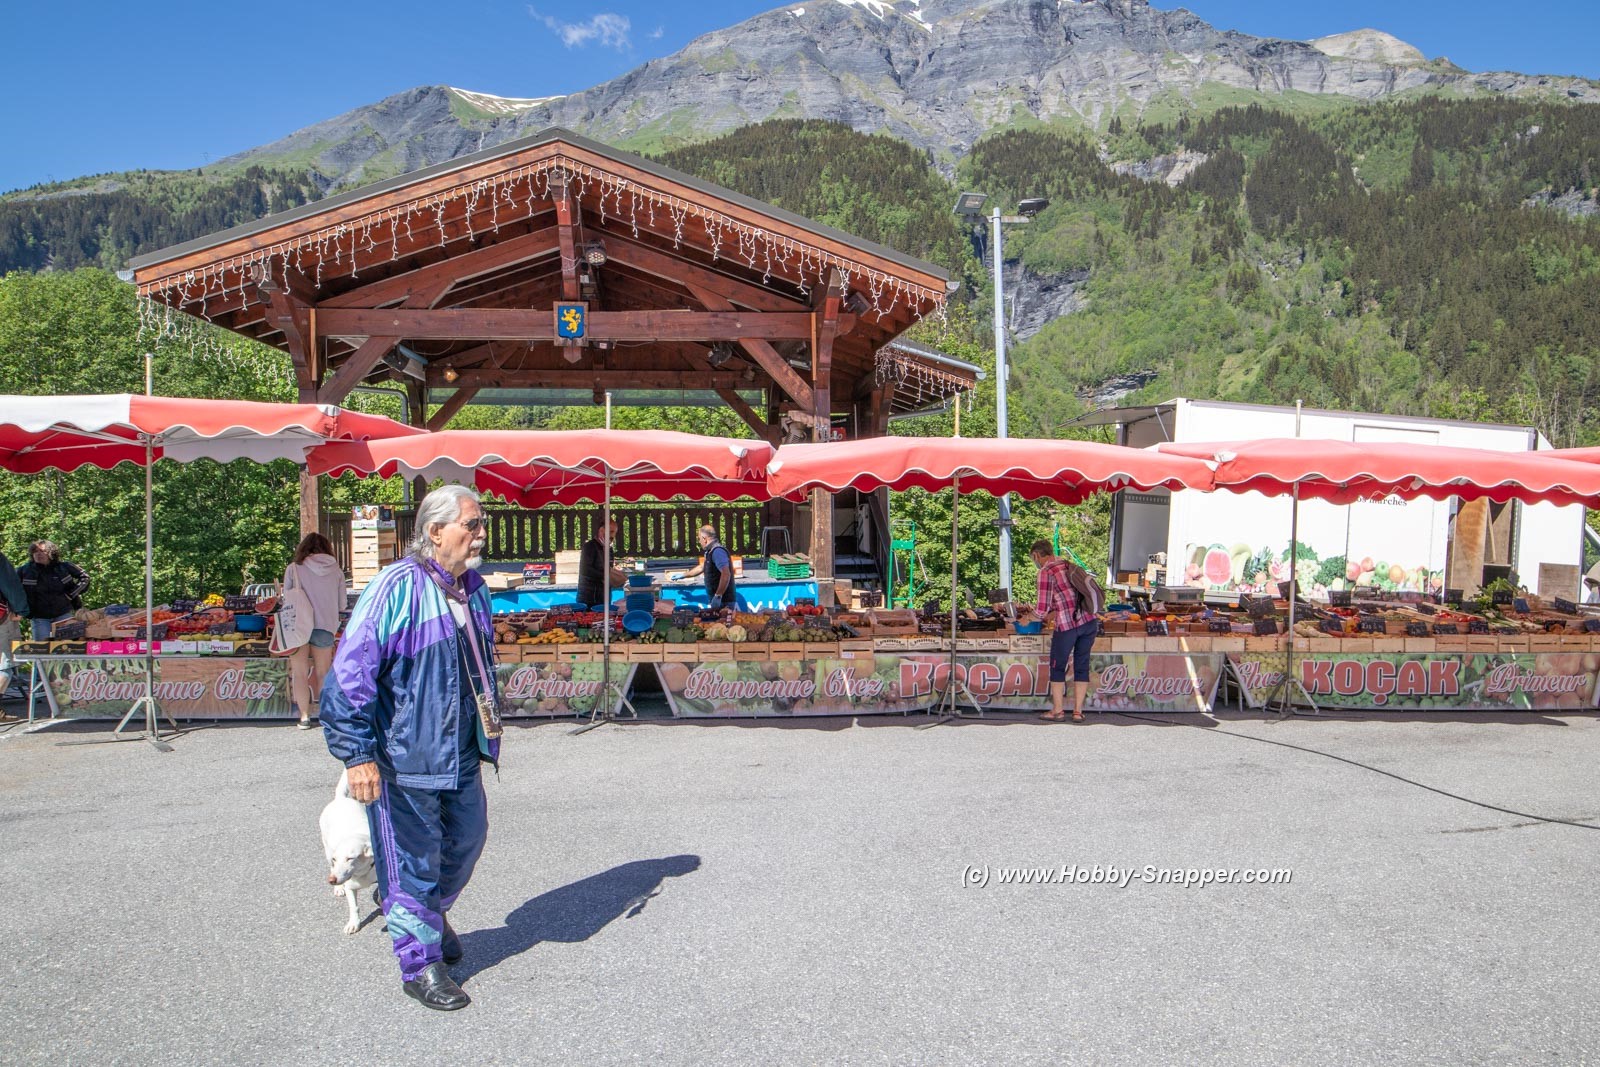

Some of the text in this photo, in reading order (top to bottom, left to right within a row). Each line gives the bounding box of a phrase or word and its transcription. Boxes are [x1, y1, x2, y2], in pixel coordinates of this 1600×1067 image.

[70, 669, 205, 700] Bienvenue
[214, 668, 275, 699] Chez
[505, 666, 605, 699] Primeu
[684, 668, 816, 699] Bienvenue
[824, 667, 883, 698] Chez
[1096, 663, 1204, 695] Primeur
[1301, 660, 1461, 705] KOÇAK
[1487, 662, 1587, 693] Primeur
